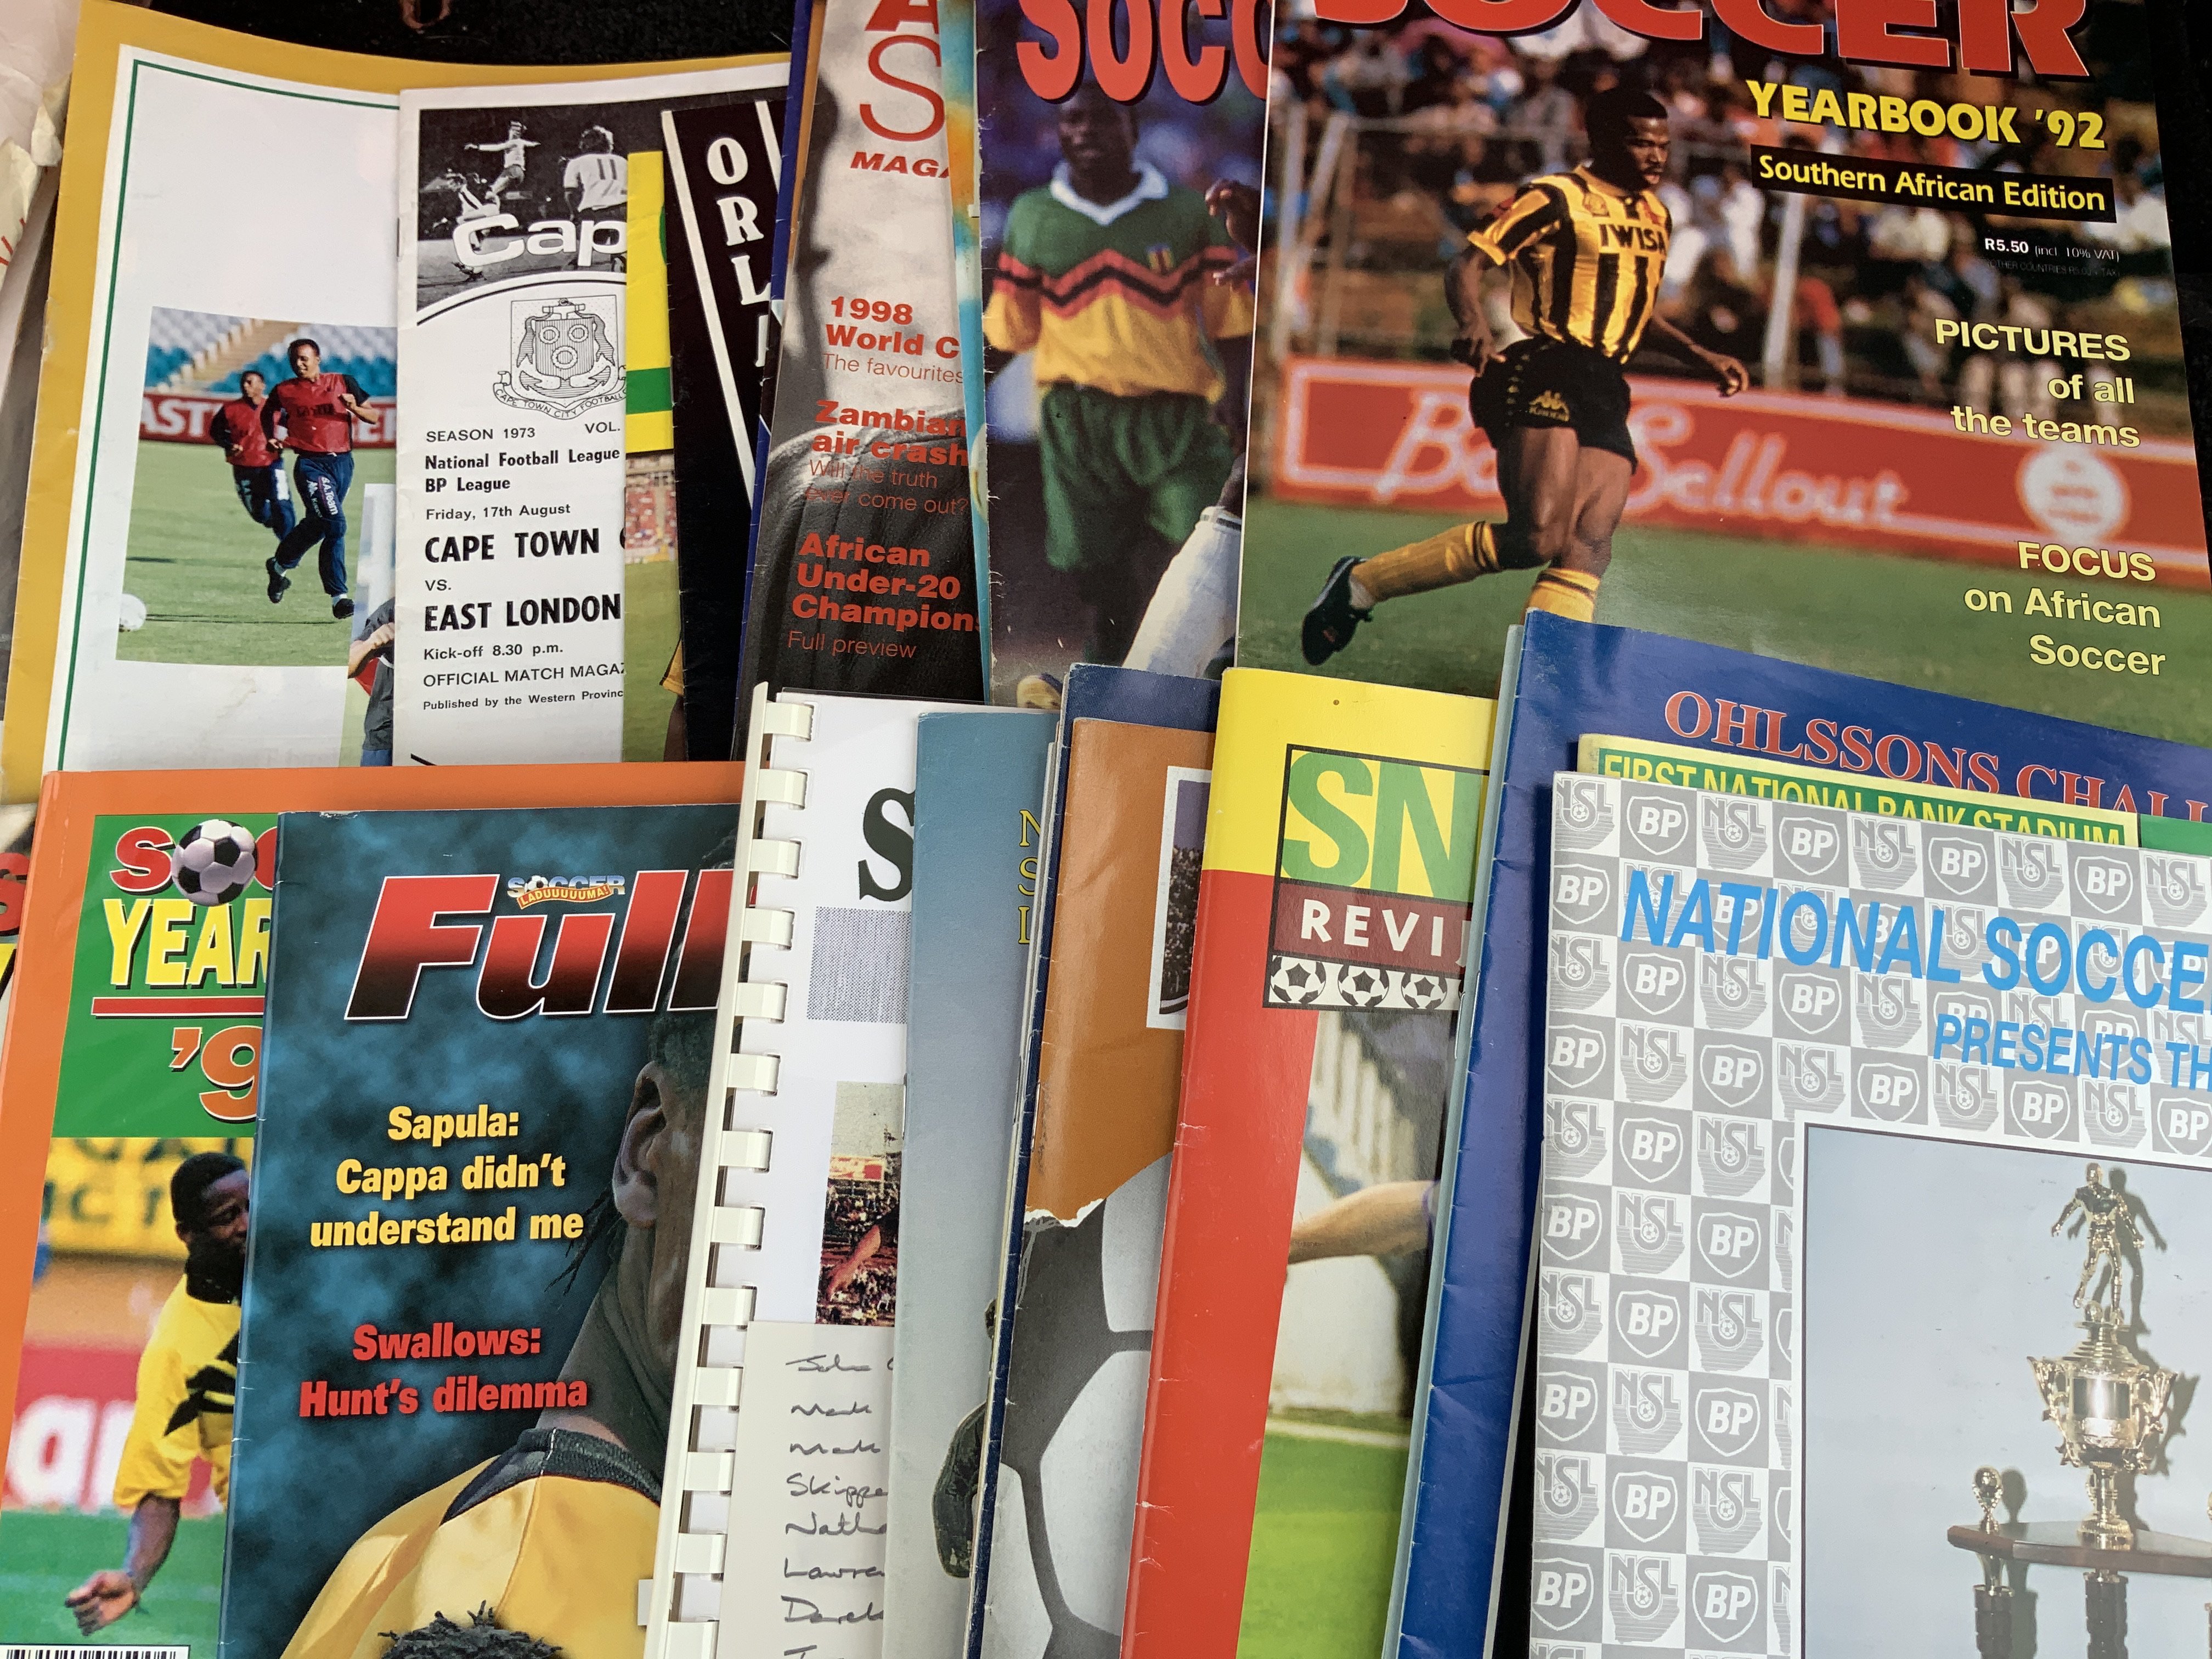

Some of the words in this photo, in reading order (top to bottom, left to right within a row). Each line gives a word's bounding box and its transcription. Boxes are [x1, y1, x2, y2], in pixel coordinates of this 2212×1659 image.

[1746, 79, 2021, 144] YEARBOOK
[2034, 110, 2106, 149] '92
[1759, 154, 1886, 193] Southern
[1894, 172, 1994, 204] African
[2004, 183, 2106, 212] Edition
[453, 213, 627, 267] Cap
[1984, 238, 2029, 253] R5.50
[2066, 247, 2091, 258] 10%
[2094, 249, 2119, 262] VAT)
[831, 296, 913, 325] 1998
[825, 324, 924, 356] World
[1934, 317, 2131, 362] PICTURES
[823, 353, 860, 372] The
[495, 389, 517, 407] CAPE
[523, 401, 551, 413] TOWN
[580, 393, 623, 410] FOOTBALL
[2048, 374, 2083, 400] of
[2094, 377, 2135, 404] all
[426, 428, 494, 442] SEASON
[503, 427, 535, 439] 1973
[585, 421, 620, 434] VOL.
[815, 399, 966, 437] Zambian
[1950, 405, 2012, 437] the
[2022, 413, 2141, 449] teams
[425, 454, 489, 470] National
[499, 450, 559, 466] Football
[568, 447, 620, 465] League
[811, 431, 860, 455] air
[871, 442, 968, 466] crash
[425, 477, 447, 493] BP
[457, 476, 511, 494] League
[810, 460, 845, 478] Will
[853, 465, 884, 483] the
[892, 470, 938, 489] truth
[426, 506, 476, 522] Friday,
[483, 505, 512, 517] 17th
[519, 503, 571, 520] August
[805, 486, 850, 503] ever
[859, 492, 917, 511] come
[924, 497, 969, 516] out?
[425, 534, 494, 563] CAPE
[515, 528, 599, 558] TOWN
[798, 532, 930, 567] African
[2017, 541, 2157, 582] FOCUS
[425, 579, 452, 591] VS.
[797, 562, 961, 600] Under-20
[424, 602, 492, 631] EAST
[506, 593, 621, 627] LONDON
[1964, 588, 2013, 614] on
[2024, 587, 2161, 629] African
[424, 646, 483, 661] Kick-off
[493, 644, 522, 656] 8.30
[532, 645, 563, 658] p.m.
[787, 630, 826, 651] Full
[832, 633, 917, 658] preview
[2029, 634, 2166, 676] Soccer
[422, 670, 499, 687] OFFICIAL
[504, 667, 565, 682] MATCH
[422, 697, 478, 711] Published
[484, 696, 499, 708] by
[504, 694, 523, 705] the
[528, 692, 575, 703] Western
[582, 688, 624, 700] Provinc
[1664, 691, 2000, 793] OHLSSONS
[1605, 754, 1696, 788] FIRST
[1281, 751, 1482, 903] SN
[1638, 806, 1681, 838] BP
[1702, 795, 1767, 851] NSL
[1791, 827, 1833, 858] BP
[1853, 816, 1915, 871] NSL
[1940, 848, 1982, 877] BP
[1998, 837, 2062, 891] NSL
[520, 885, 609, 906] LADUUUUUMA!
[1556, 875, 1603, 906] BP
[2086, 866, 2126, 896] BP
[2145, 855, 2206, 909] NSL
[345, 869, 734, 1019] Full
[1621, 870, 1961, 983] NATIONAL
[1982, 917, 2212, 1015] SOCCE
[1635, 964, 1679, 996] BP
[1701, 951, 1766, 1009] NSL
[1791, 984, 1835, 1015] BP
[1855, 972, 1919, 1029] NSL
[1551, 1036, 1599, 1068] BP
[1621, 1023, 1687, 1082] NSL
[1934, 1014, 2152, 1085] PRESENTS
[1712, 1056, 1756, 1088] BP
[1779, 1044, 1844, 1101] NSL
[1933, 1061, 1997, 1118] NSL
[1869, 1075, 1914, 1105] BP
[2022, 1092, 2063, 1123] BP
[2083, 1079, 2145, 1134] NSL
[388, 1104, 519, 1147] Sapula:
[2169, 1108, 2209, 1139] BP
[1632, 1129, 1676, 1163] BP
[1697, 1115, 1764, 1176] NSL
[336, 1159, 448, 1200] Cappa
[462, 1153, 566, 1190] didn't
[310, 1207, 516, 1248] understand
[529, 1215, 584, 1240] me
[1547, 1205, 1595, 1240] BP
[1616, 1190, 1684, 1254] NSL
[1709, 1224, 1754, 1257] BP
[1628, 1302, 1673, 1337] BP
[1694, 1287, 1762, 1350] NSL
[352, 1322, 541, 1361] Swallows:
[299, 1379, 419, 1418] Hunt's
[433, 1376, 588, 1413] dilemma
[1542, 1384, 1591, 1419] BP
[1613, 1368, 1681, 1431] NSL
[1708, 1401, 1753, 1435] BP
[1624, 1484, 1671, 1520] BP
[1692, 1468, 1761, 1531] NSL
[1537, 1571, 1587, 1608] BP
[1609, 1553, 1678, 1619] NSL
[1705, 1584, 1752, 1620] BP
